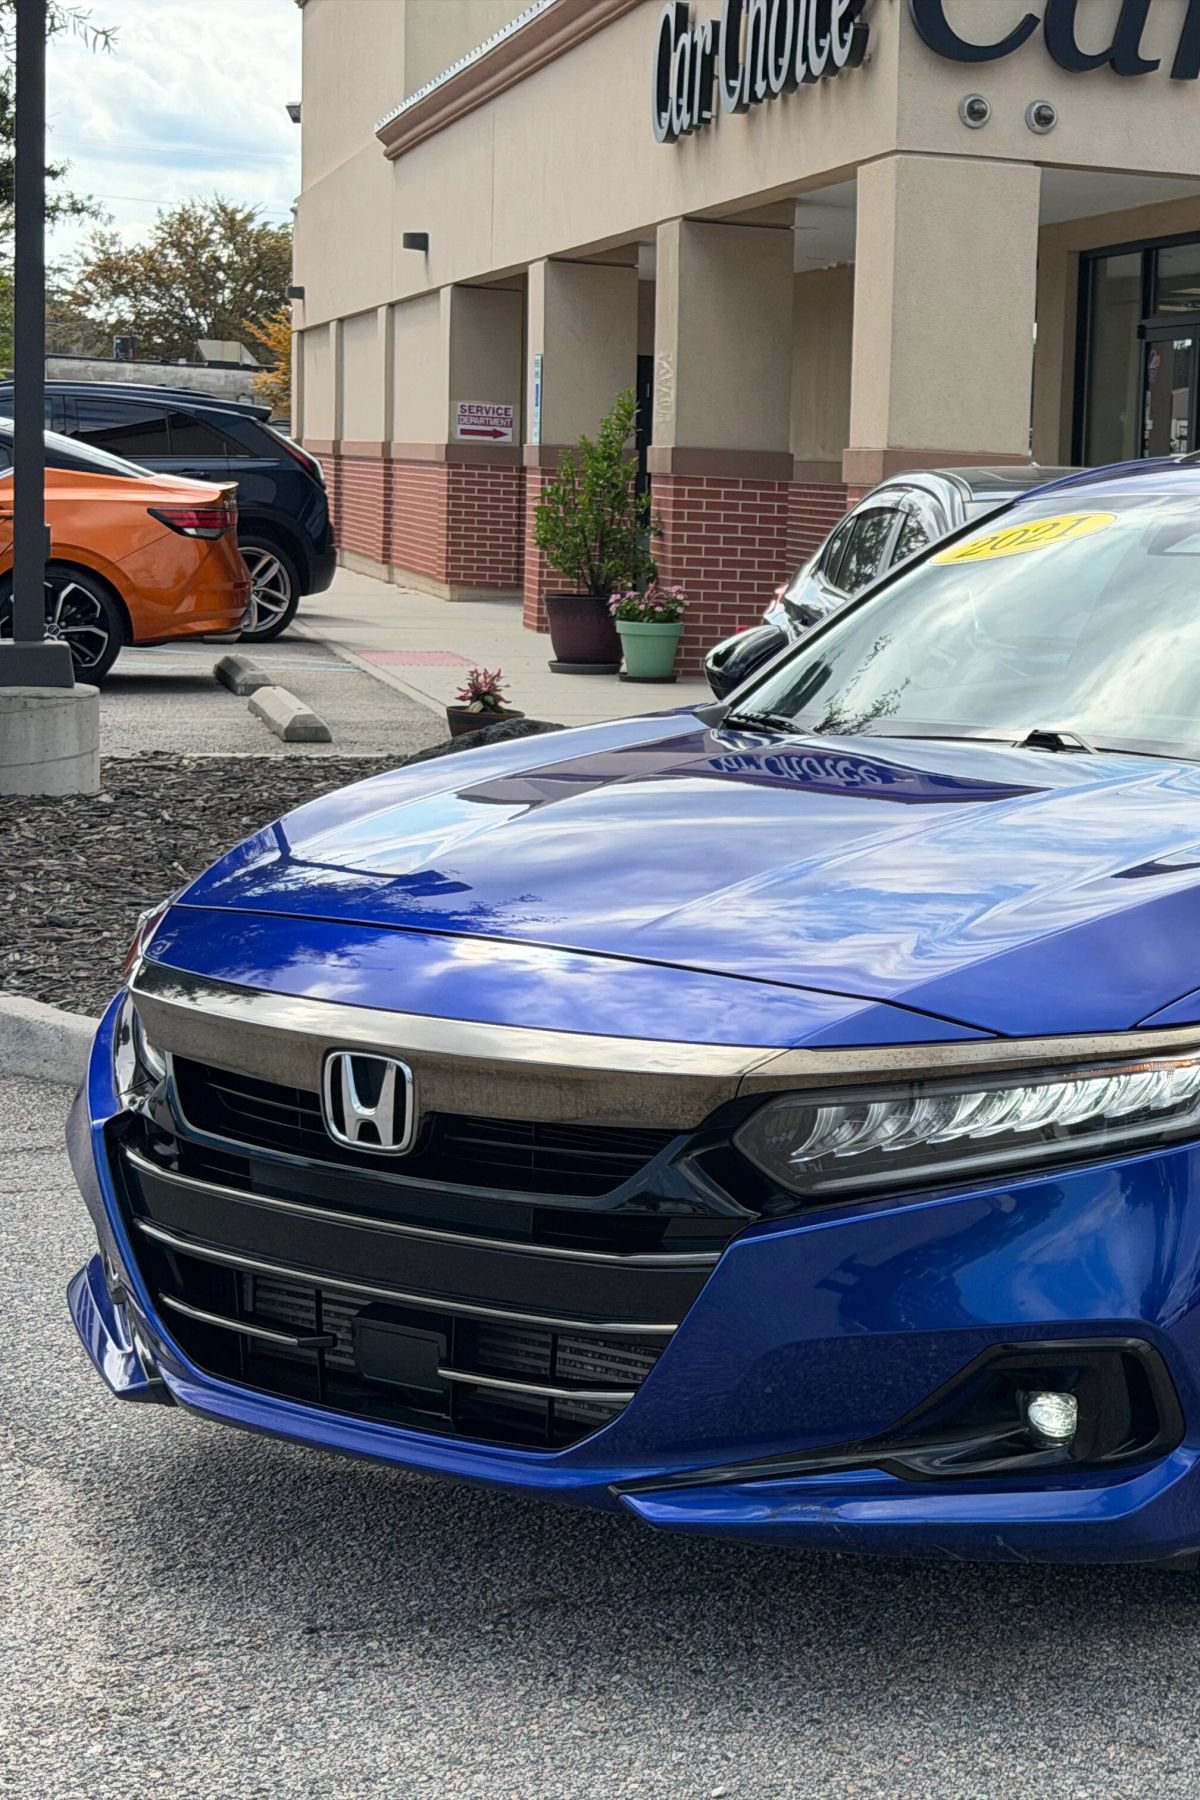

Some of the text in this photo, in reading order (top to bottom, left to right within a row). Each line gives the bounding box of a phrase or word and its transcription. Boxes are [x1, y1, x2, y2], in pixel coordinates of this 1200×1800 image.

[652, 1, 719, 144] Car
[459, 416, 511, 426] DEPARTMENT
[460, 404, 512, 416] SERVICE
[955, 515, 1092, 559] 2021
